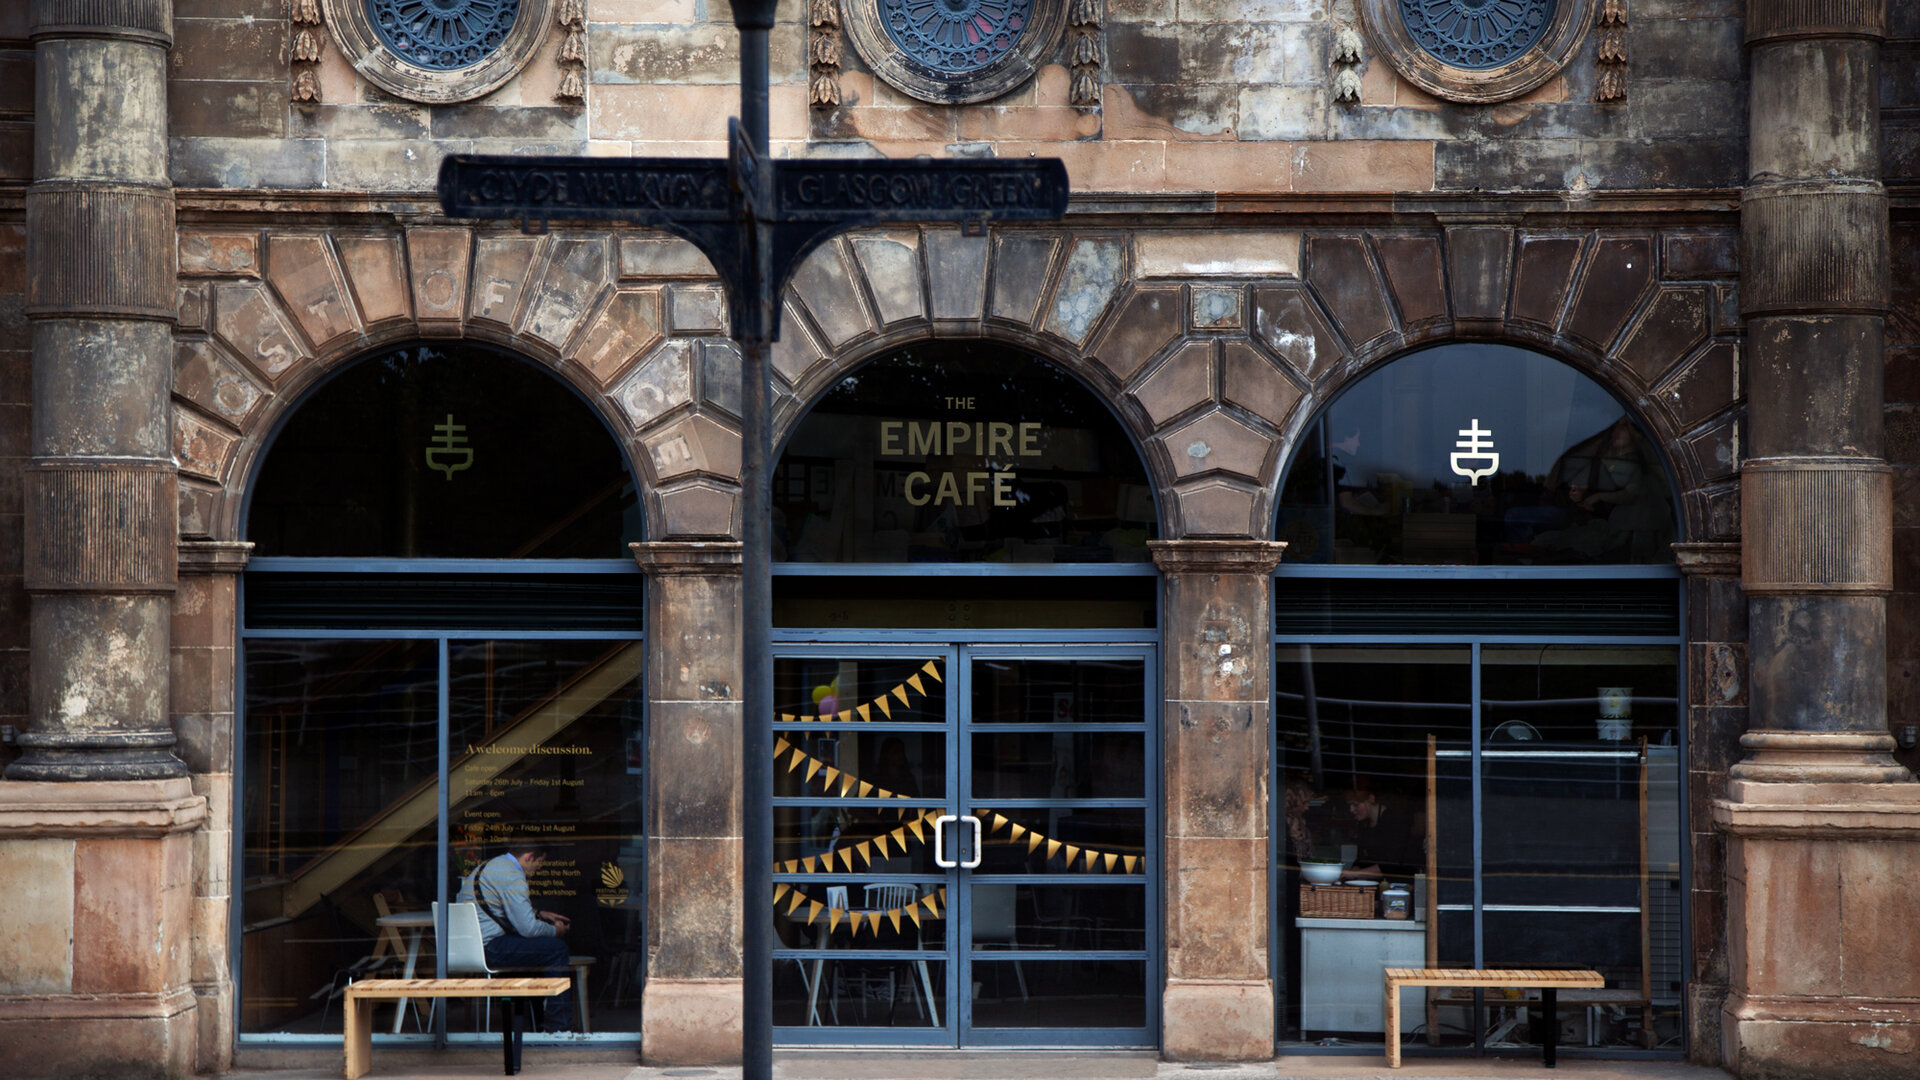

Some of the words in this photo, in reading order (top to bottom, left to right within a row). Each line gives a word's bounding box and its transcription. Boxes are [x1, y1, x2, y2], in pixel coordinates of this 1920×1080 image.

[480, 168, 568, 202] CLYDE
[577, 169, 715, 204] WALKWAY
[797, 172, 939, 205] GLASGOW
[949, 171, 1038, 208] GREEN
[944, 396, 976, 410] THE
[880, 421, 1042, 456] EMPIRE
[904, 463, 1017, 506] CAFÉ
[465, 744, 476, 755] A
[476, 743, 528, 755] welcome
[529, 743, 593, 755] discussion.
[464, 778, 493, 787] Saturday
[494, 778, 510, 786] 26th
[511, 778, 523, 787] July
[529, 778, 549, 787] Friday
[551, 778, 561, 786] 1st
[562, 778, 585, 788] August
[464, 809, 482, 818] Event
[464, 824, 484, 833] Friday
[501, 824, 514, 833] July
[521, 824, 541, 833] Friday
[542, 824, 552, 832] 1st
[553, 824, 576, 834] August
[569, 859, 576, 867] of
[536, 869, 550, 877] with
[550, 869, 561, 877] the
[562, 869, 582, 877] North
[542, 889, 577, 897] workshops
